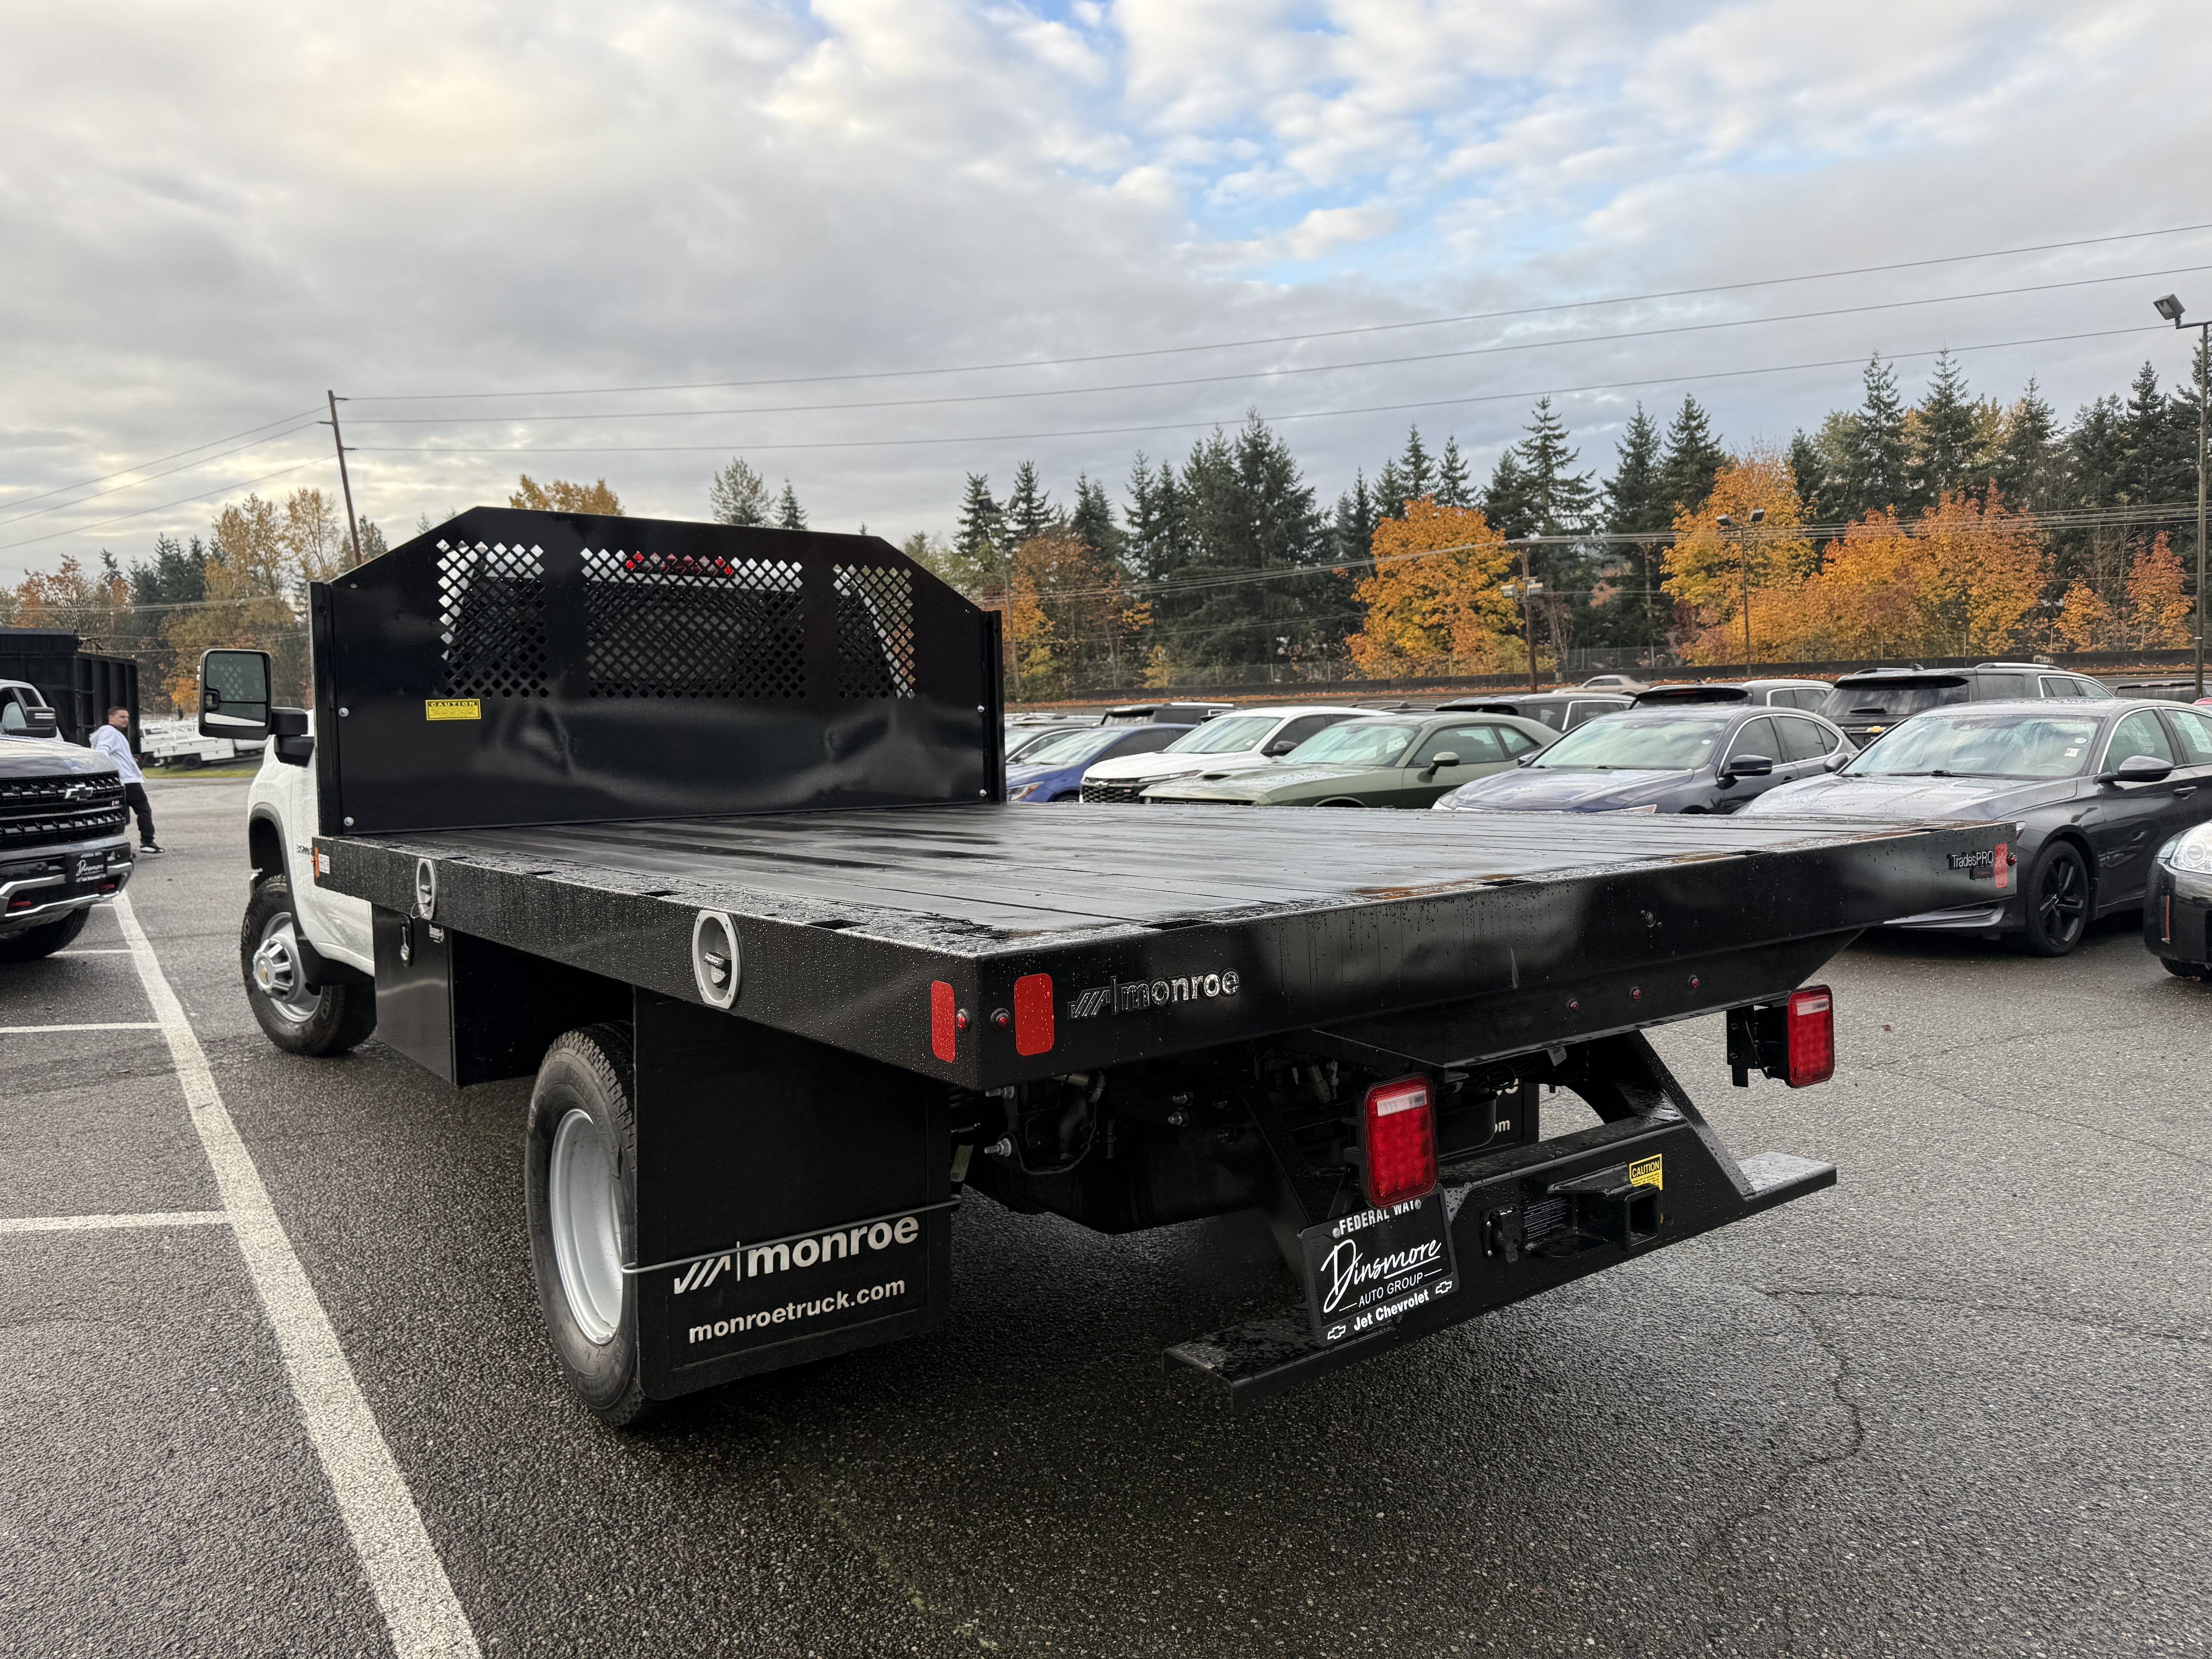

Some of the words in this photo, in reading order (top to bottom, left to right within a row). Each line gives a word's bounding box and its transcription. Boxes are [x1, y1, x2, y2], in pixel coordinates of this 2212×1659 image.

[1952, 851, 1994, 867] TradesPRO
[1122, 971, 1239, 1010] monroe
[1632, 1161, 1659, 1177] CAUTION
[1339, 1209, 1389, 1235] FEDERAL
[747, 1216, 919, 1277] monroe
[1320, 1239, 1441, 1313] Dinsmore
[1358, 1287, 1384, 1307] AUTO
[1387, 1273, 1424, 1293] GROUP
[689, 1279, 905, 1343] monroetruck.com
[1353, 1313, 1373, 1331] Jet
[1376, 1290, 1429, 1321] Chevrolet
